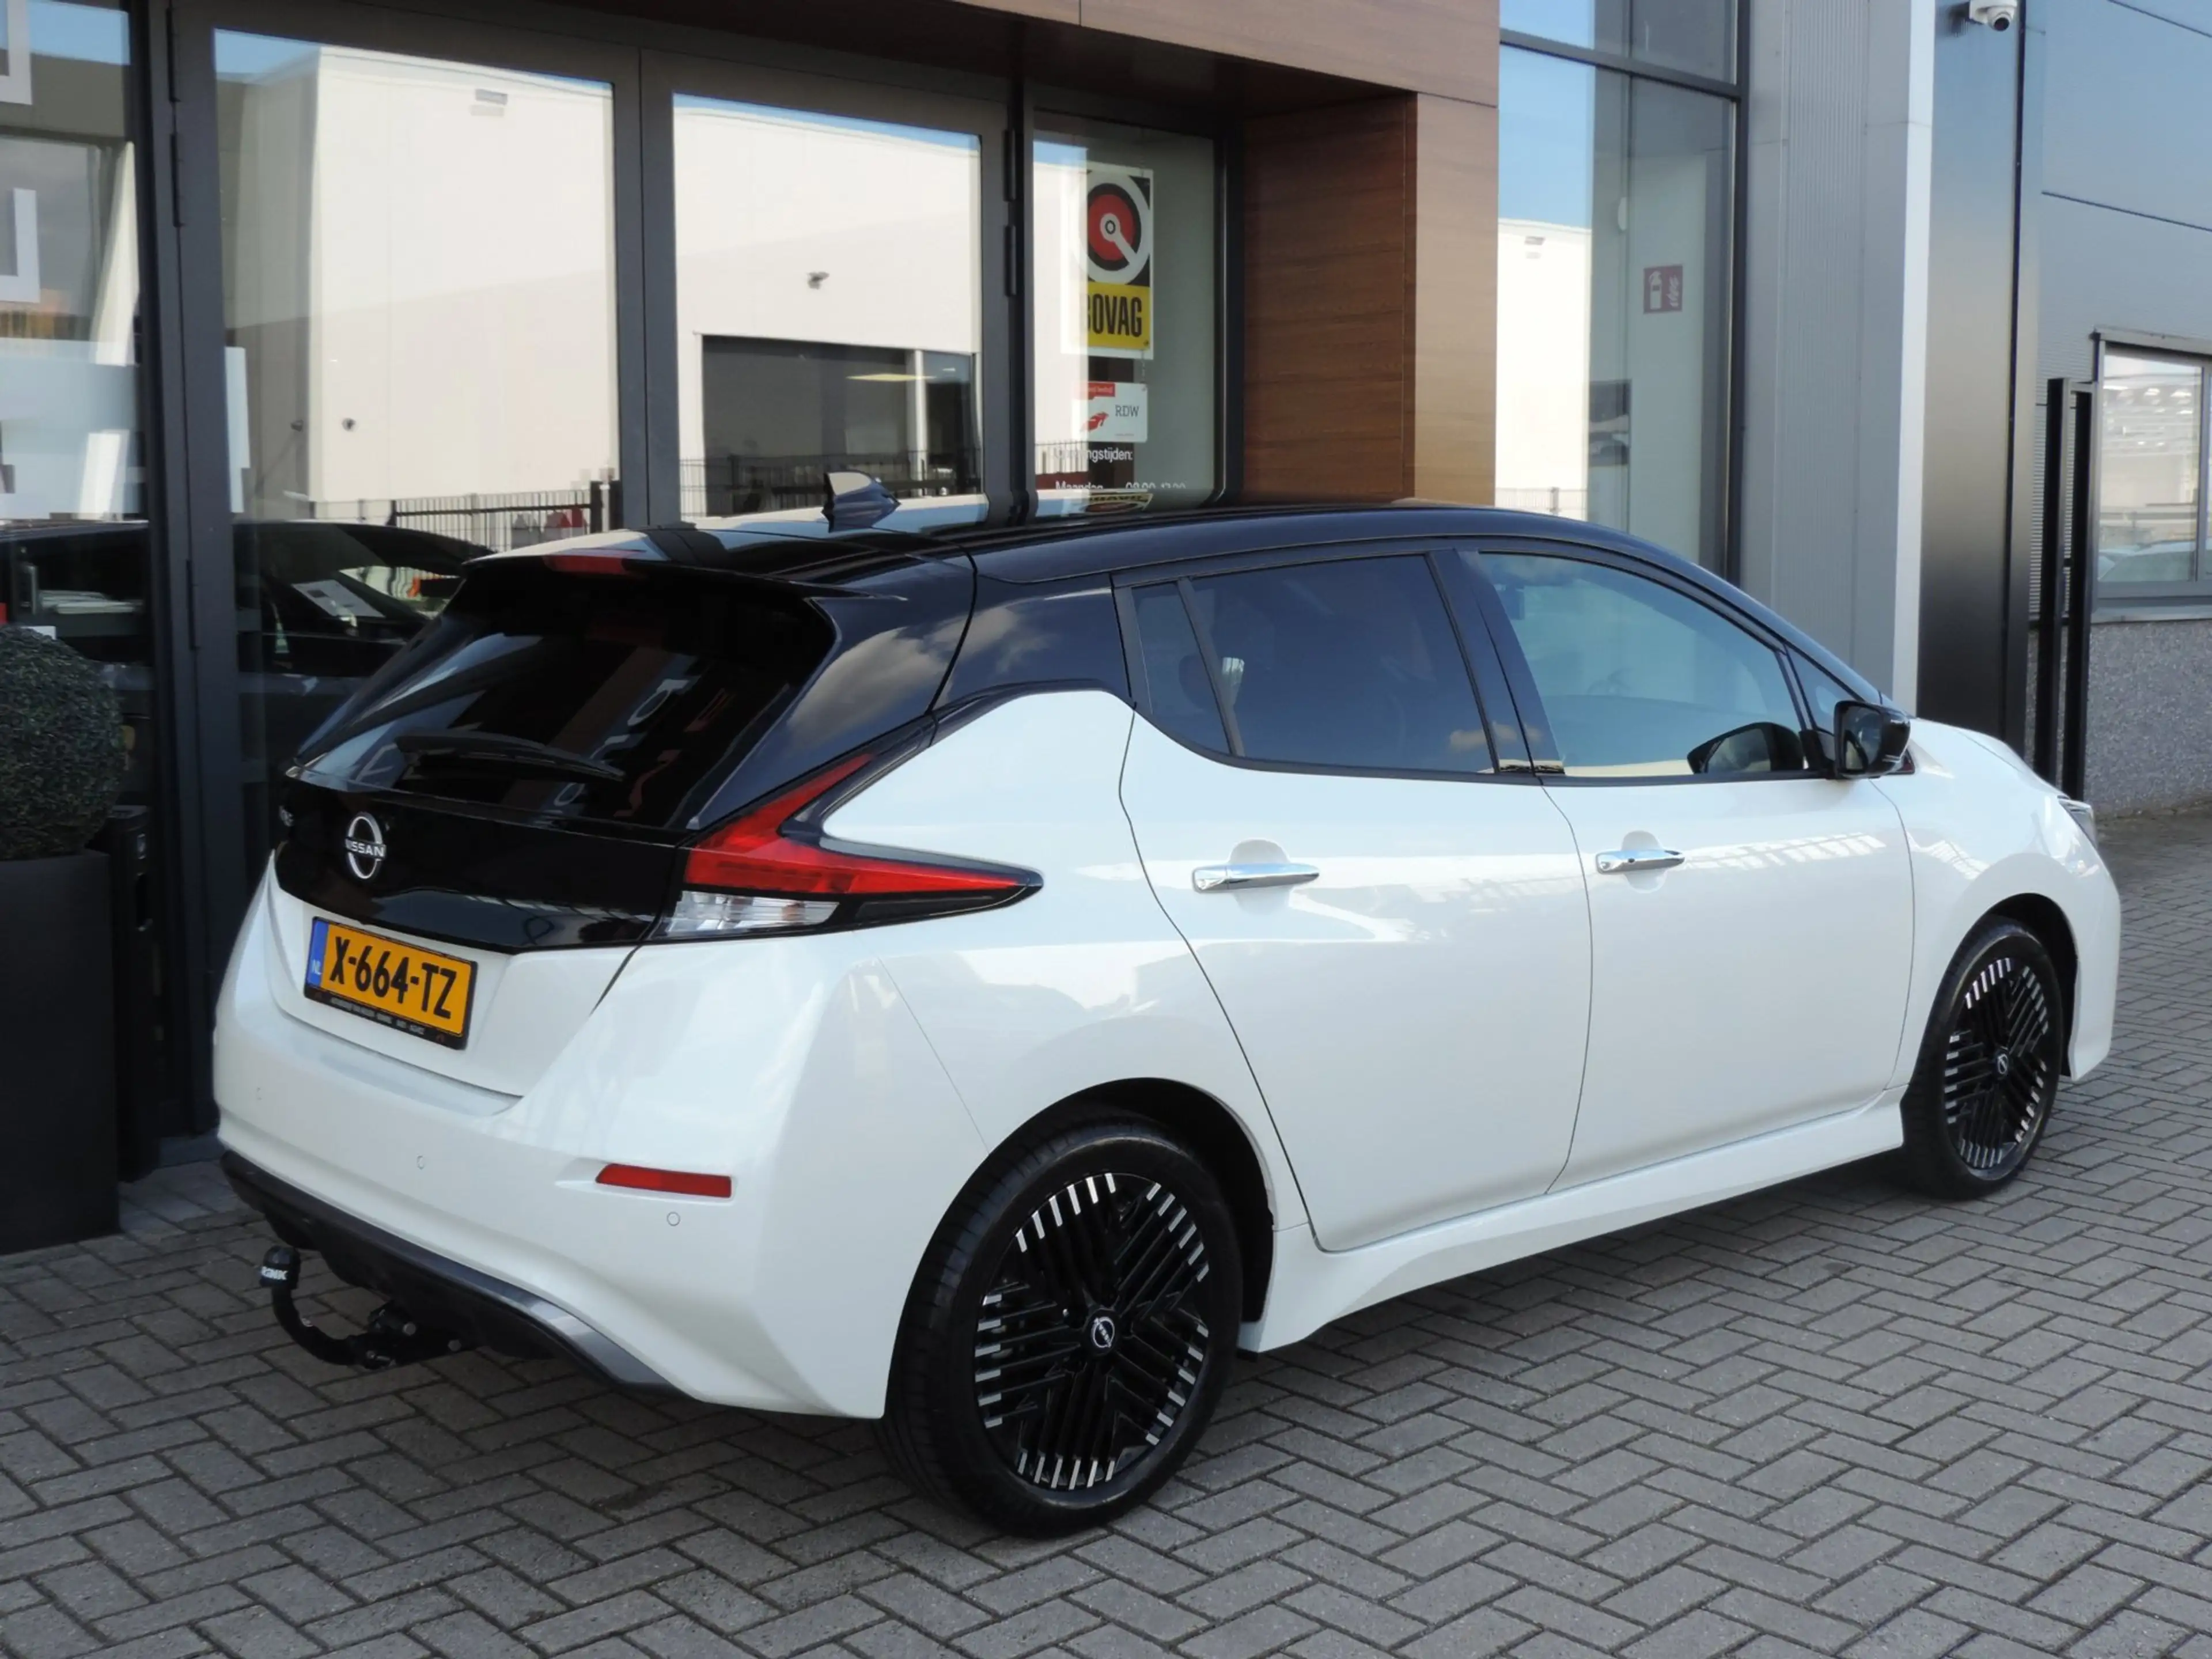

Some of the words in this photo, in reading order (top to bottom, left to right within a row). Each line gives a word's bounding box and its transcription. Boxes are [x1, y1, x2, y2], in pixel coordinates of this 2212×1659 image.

[1115, 404, 1139, 418] RDW
[1055, 448, 1133, 463] ngstijden:
[329, 937, 457, 1019] X-664-TZ
